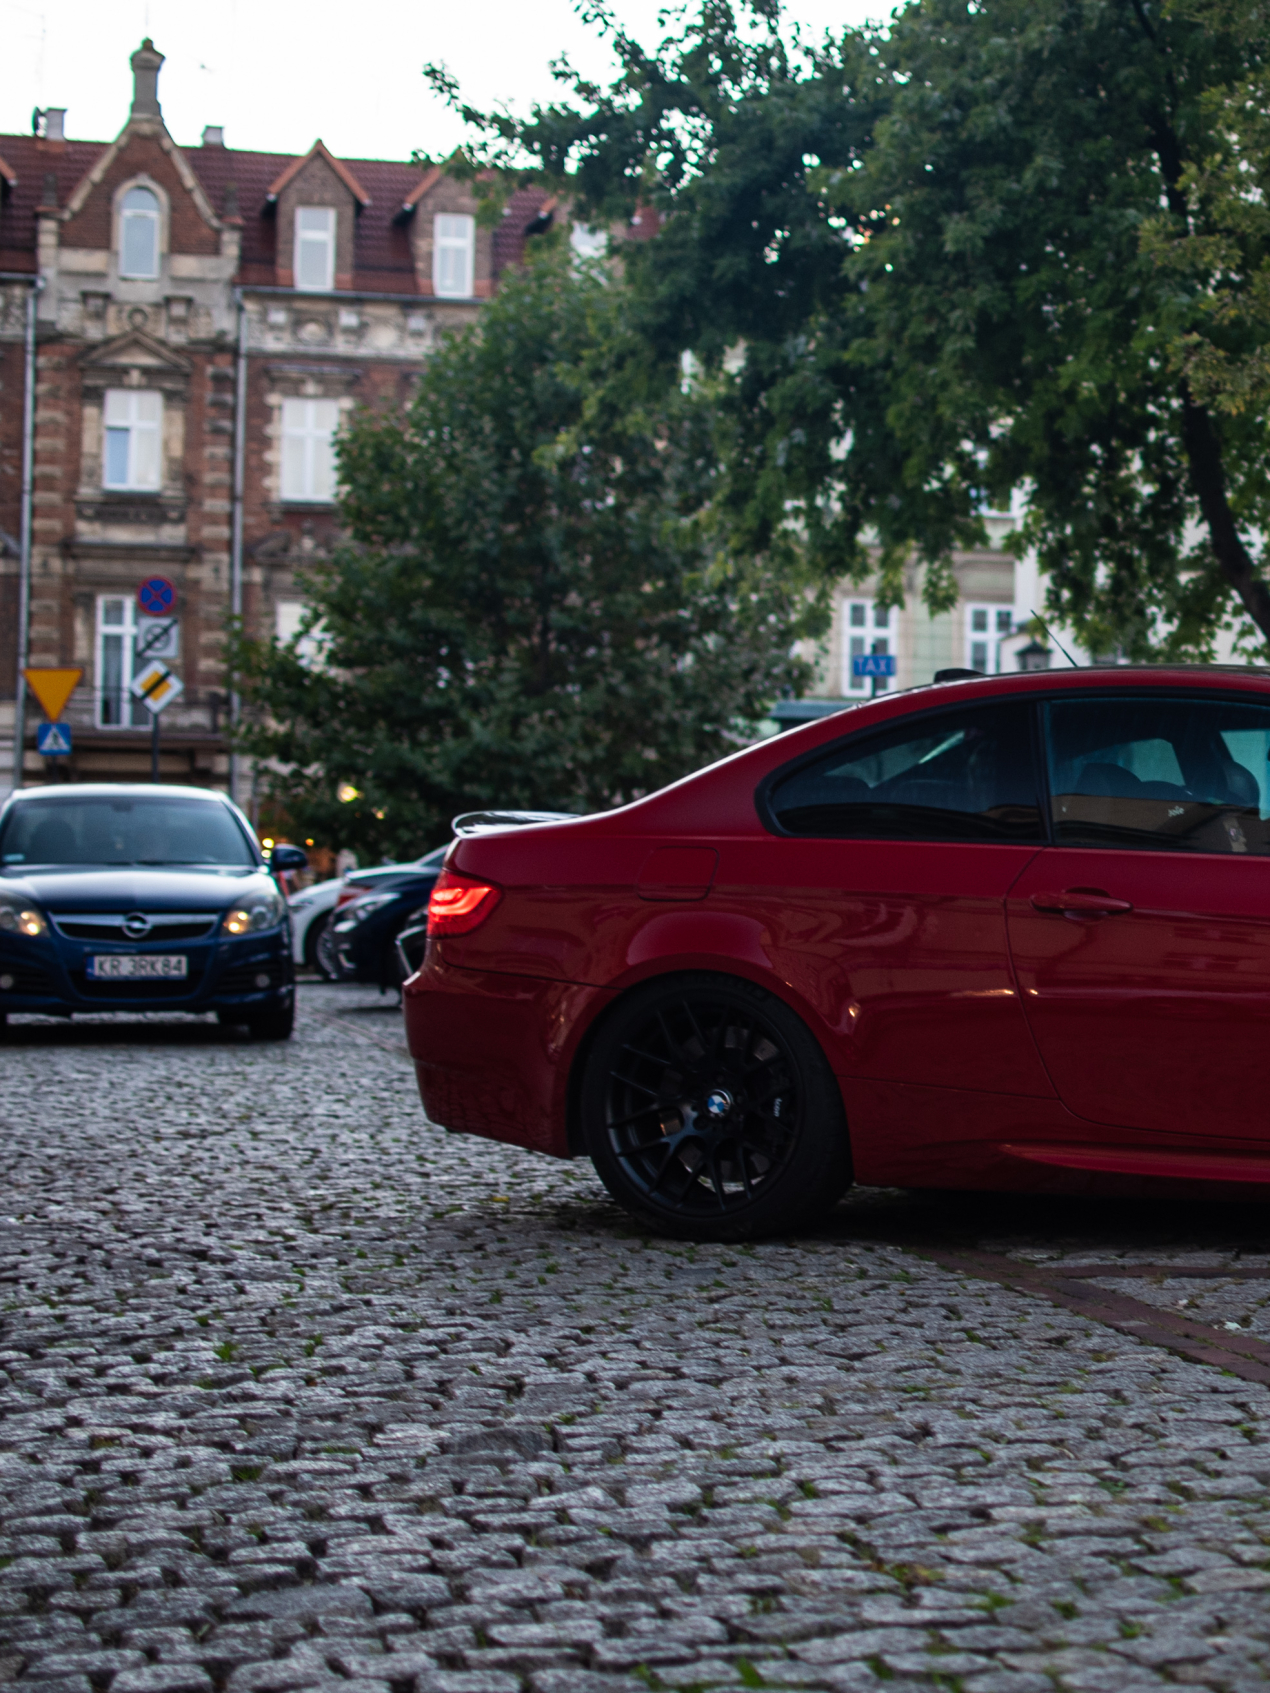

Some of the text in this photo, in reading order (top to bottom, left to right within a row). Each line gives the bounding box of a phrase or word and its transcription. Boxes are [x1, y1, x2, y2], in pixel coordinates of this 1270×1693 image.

[855, 657, 894, 674] TAXI
[98, 957, 183, 976] KR 3RK84
